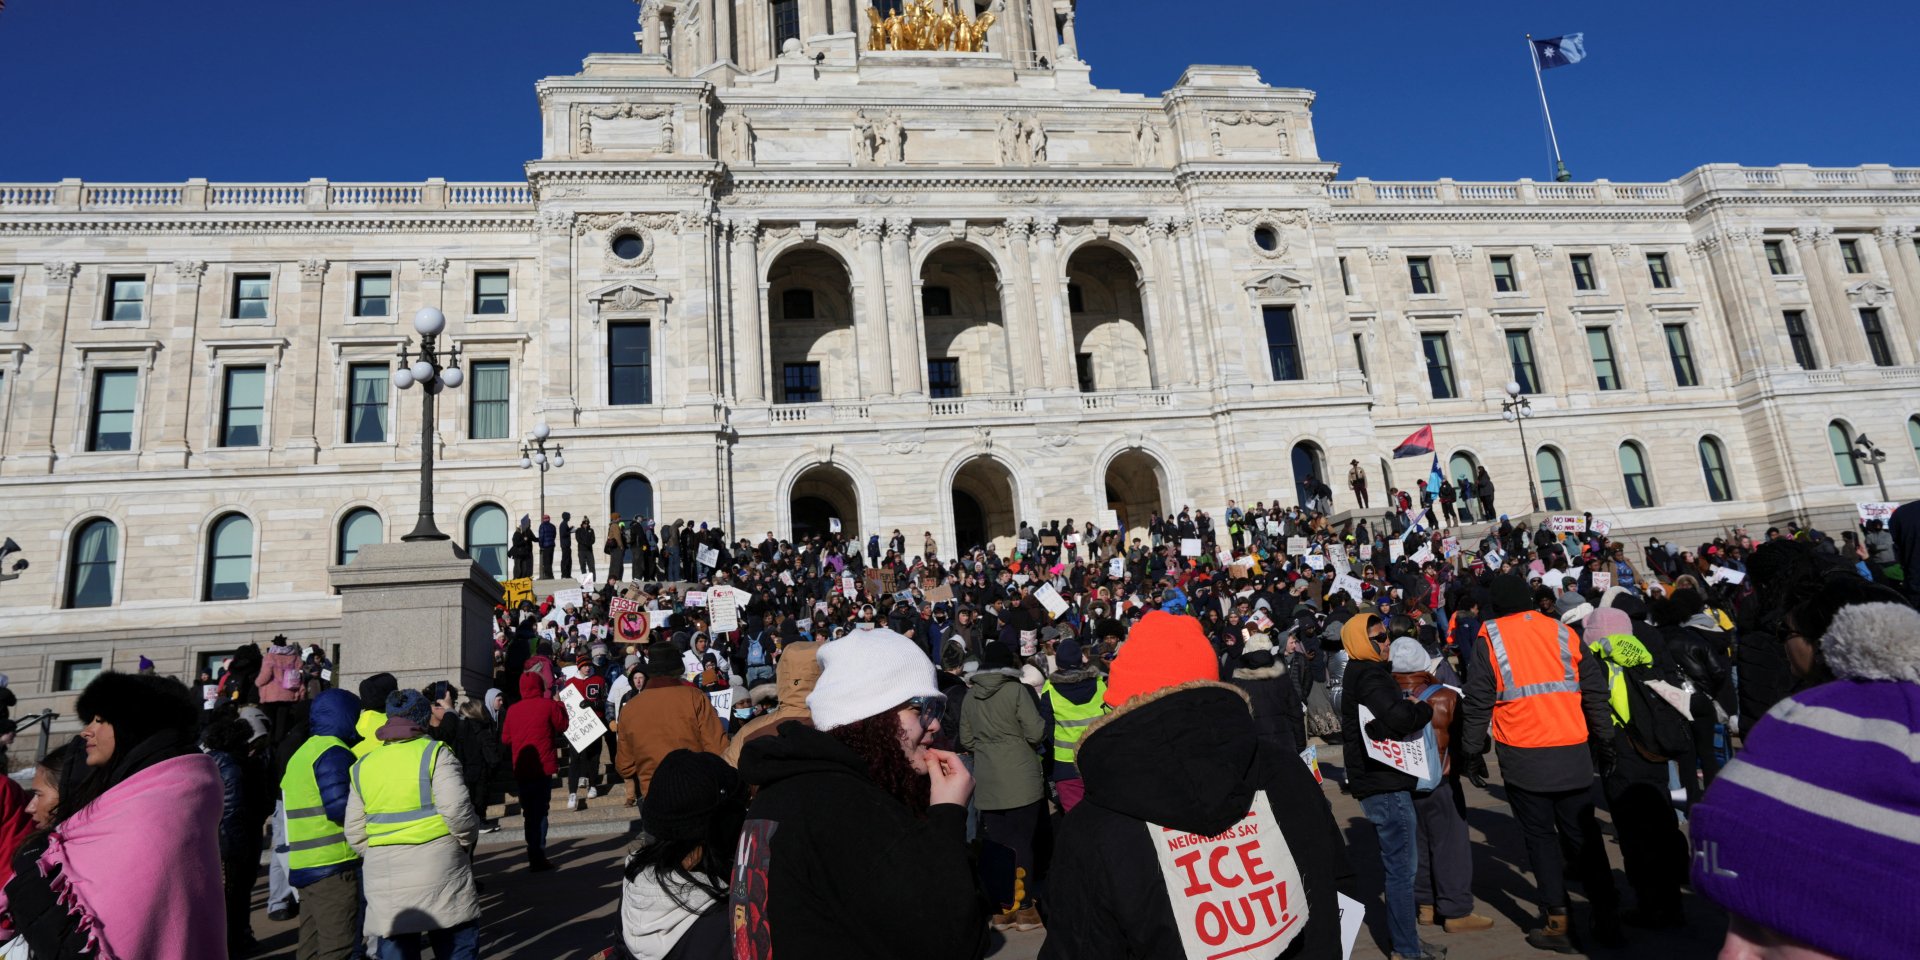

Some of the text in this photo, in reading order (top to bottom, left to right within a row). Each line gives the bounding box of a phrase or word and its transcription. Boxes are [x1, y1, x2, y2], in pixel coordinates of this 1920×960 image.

[1621, 649, 1645, 663] DEFEN
[1391, 742, 1405, 770] NO
[1239, 824, 1258, 838] SAY
[1175, 840, 1275, 897] ICE
[1195, 881, 1288, 946] OUT!
